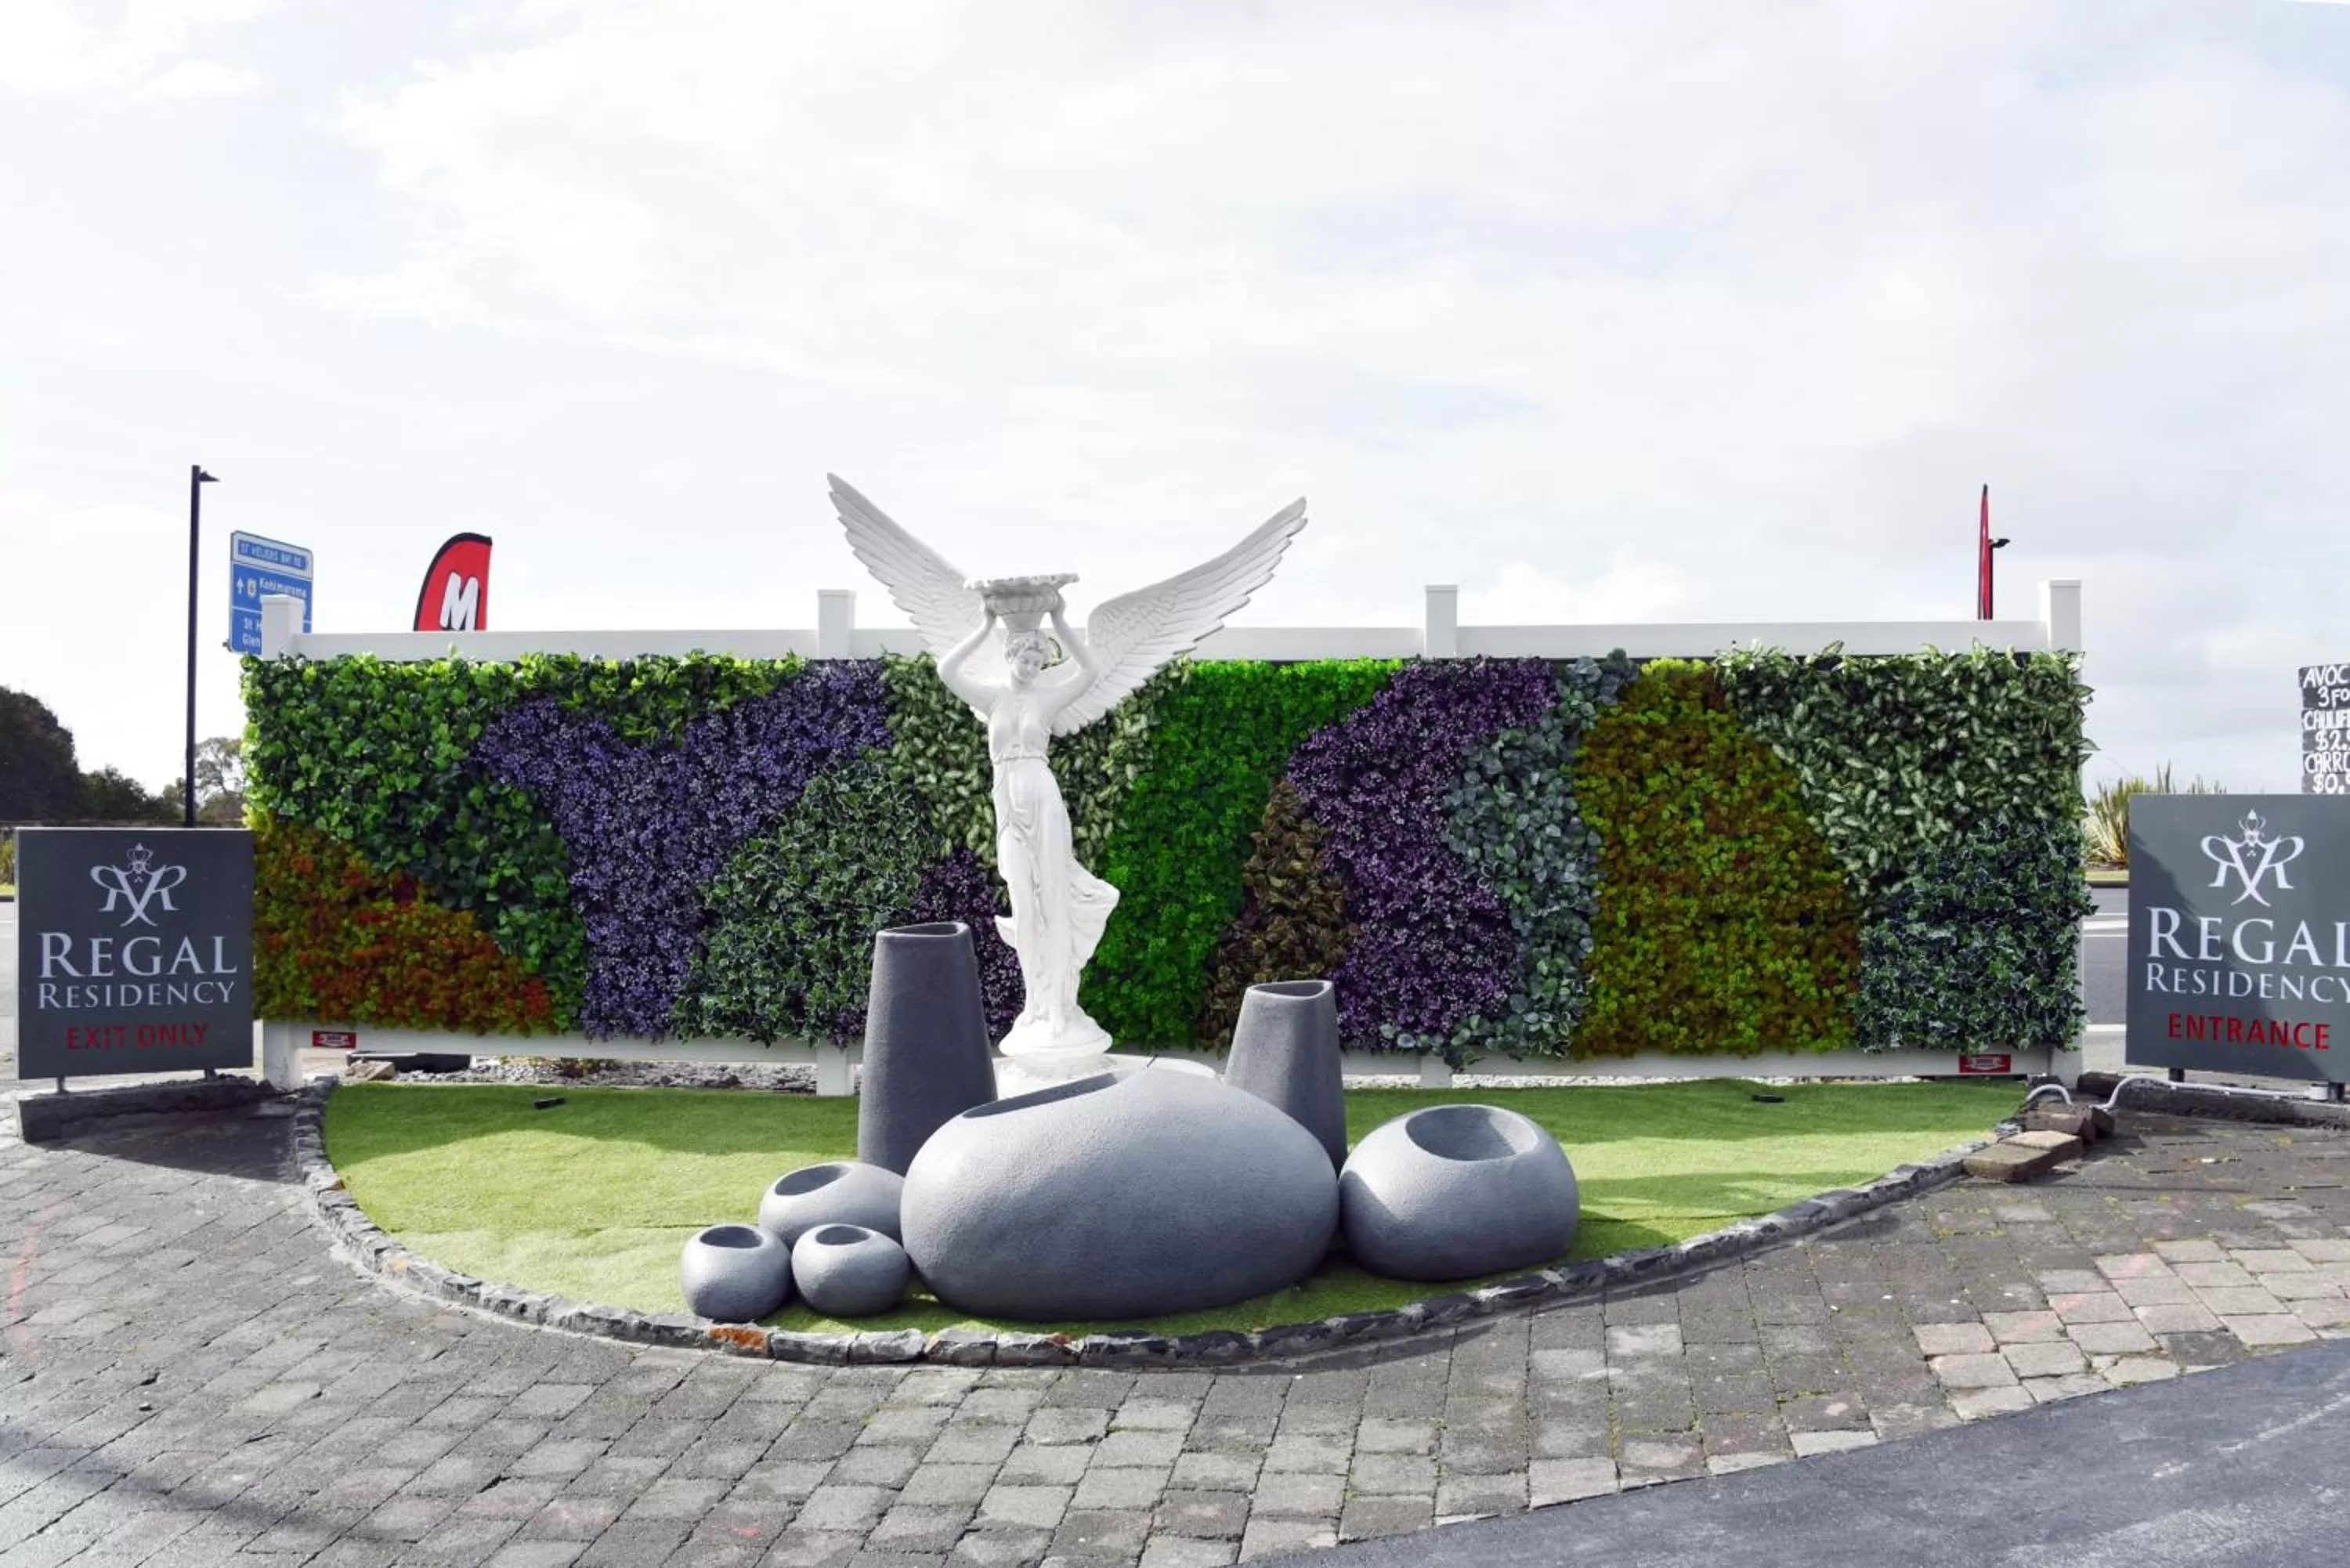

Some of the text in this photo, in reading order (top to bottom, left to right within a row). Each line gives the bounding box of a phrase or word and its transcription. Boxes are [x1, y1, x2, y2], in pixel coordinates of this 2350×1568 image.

[439, 571, 479, 630] M
[2331, 688, 2350, 708] FO
[38, 931, 237, 978] REGAL
[2146, 906, 2350, 967] REGAL
[38, 981, 235, 1010] RESIDENCY
[2146, 963, 2350, 1004] RESIDENCY
[67, 1023, 209, 1052] EXIT ONLY
[2167, 1012, 2332, 1050] ENTRANCE
